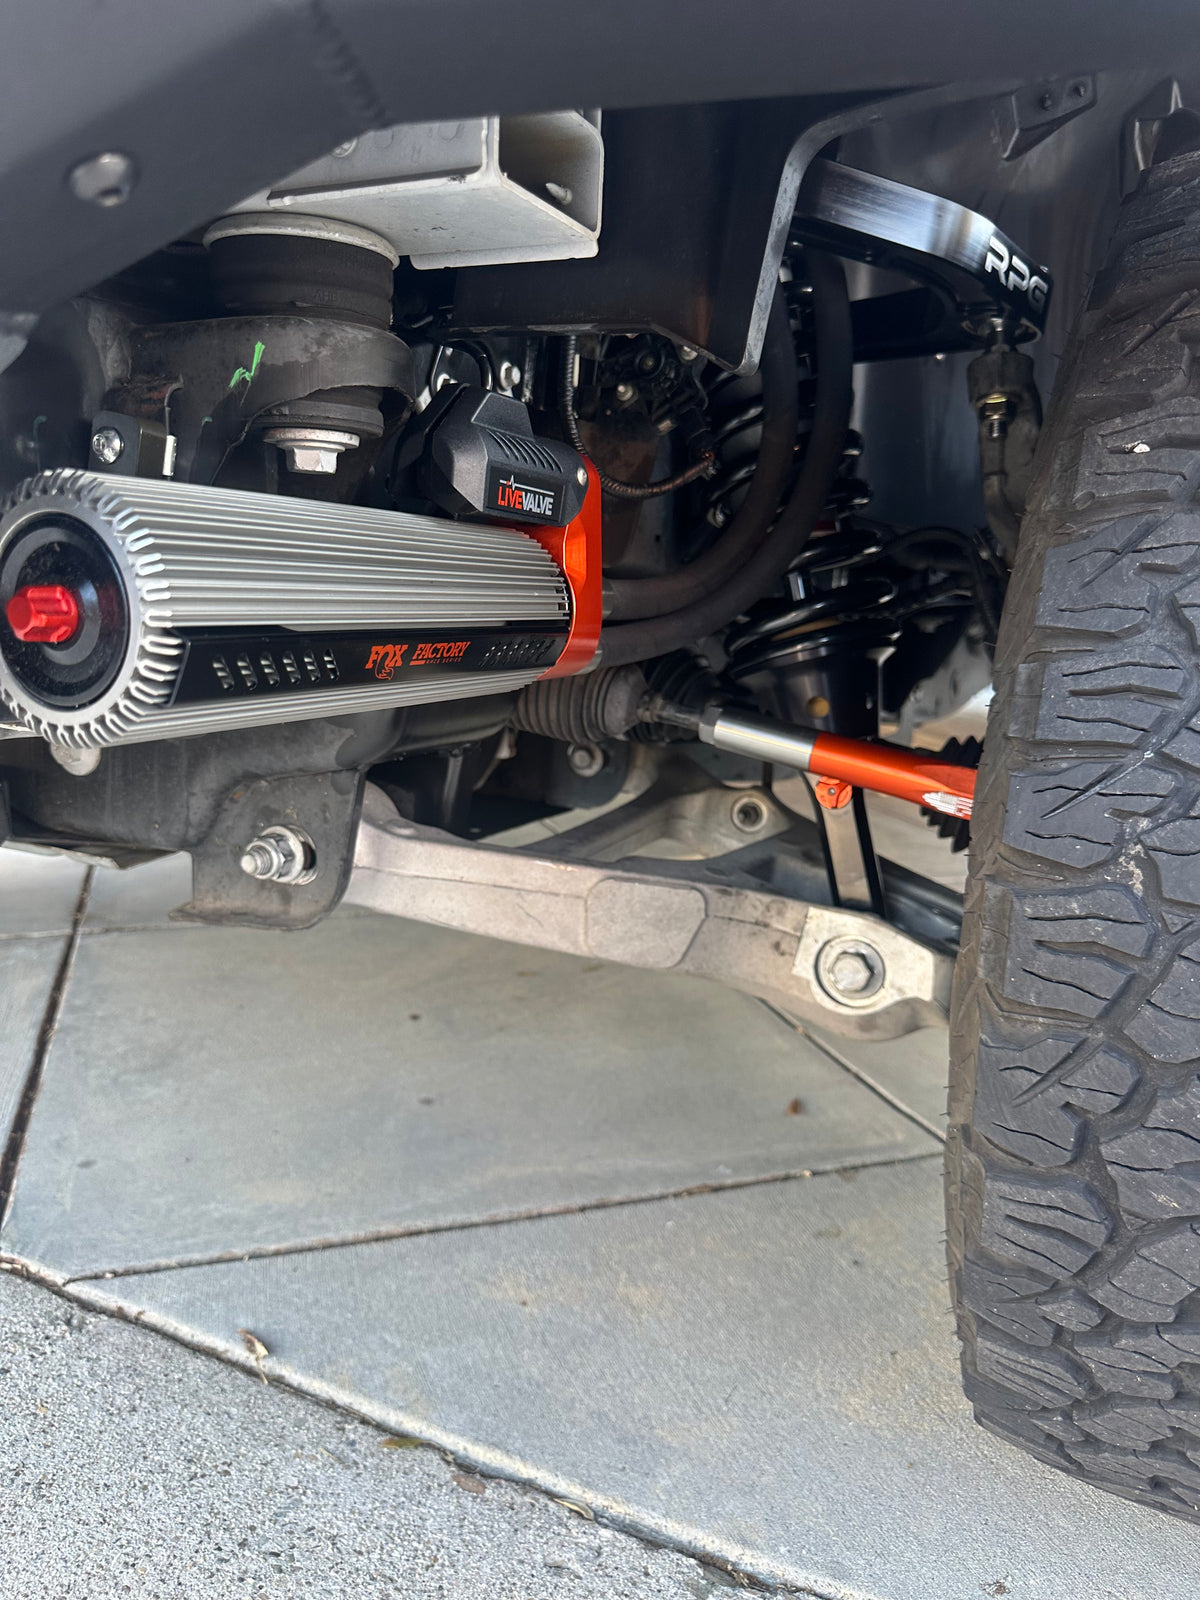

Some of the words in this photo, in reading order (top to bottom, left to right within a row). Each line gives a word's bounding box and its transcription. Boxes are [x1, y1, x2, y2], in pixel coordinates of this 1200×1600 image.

[985, 236, 1048, 312] RPG
[365, 644, 408, 675] FOX
[412, 641, 471, 659] FACTORY
